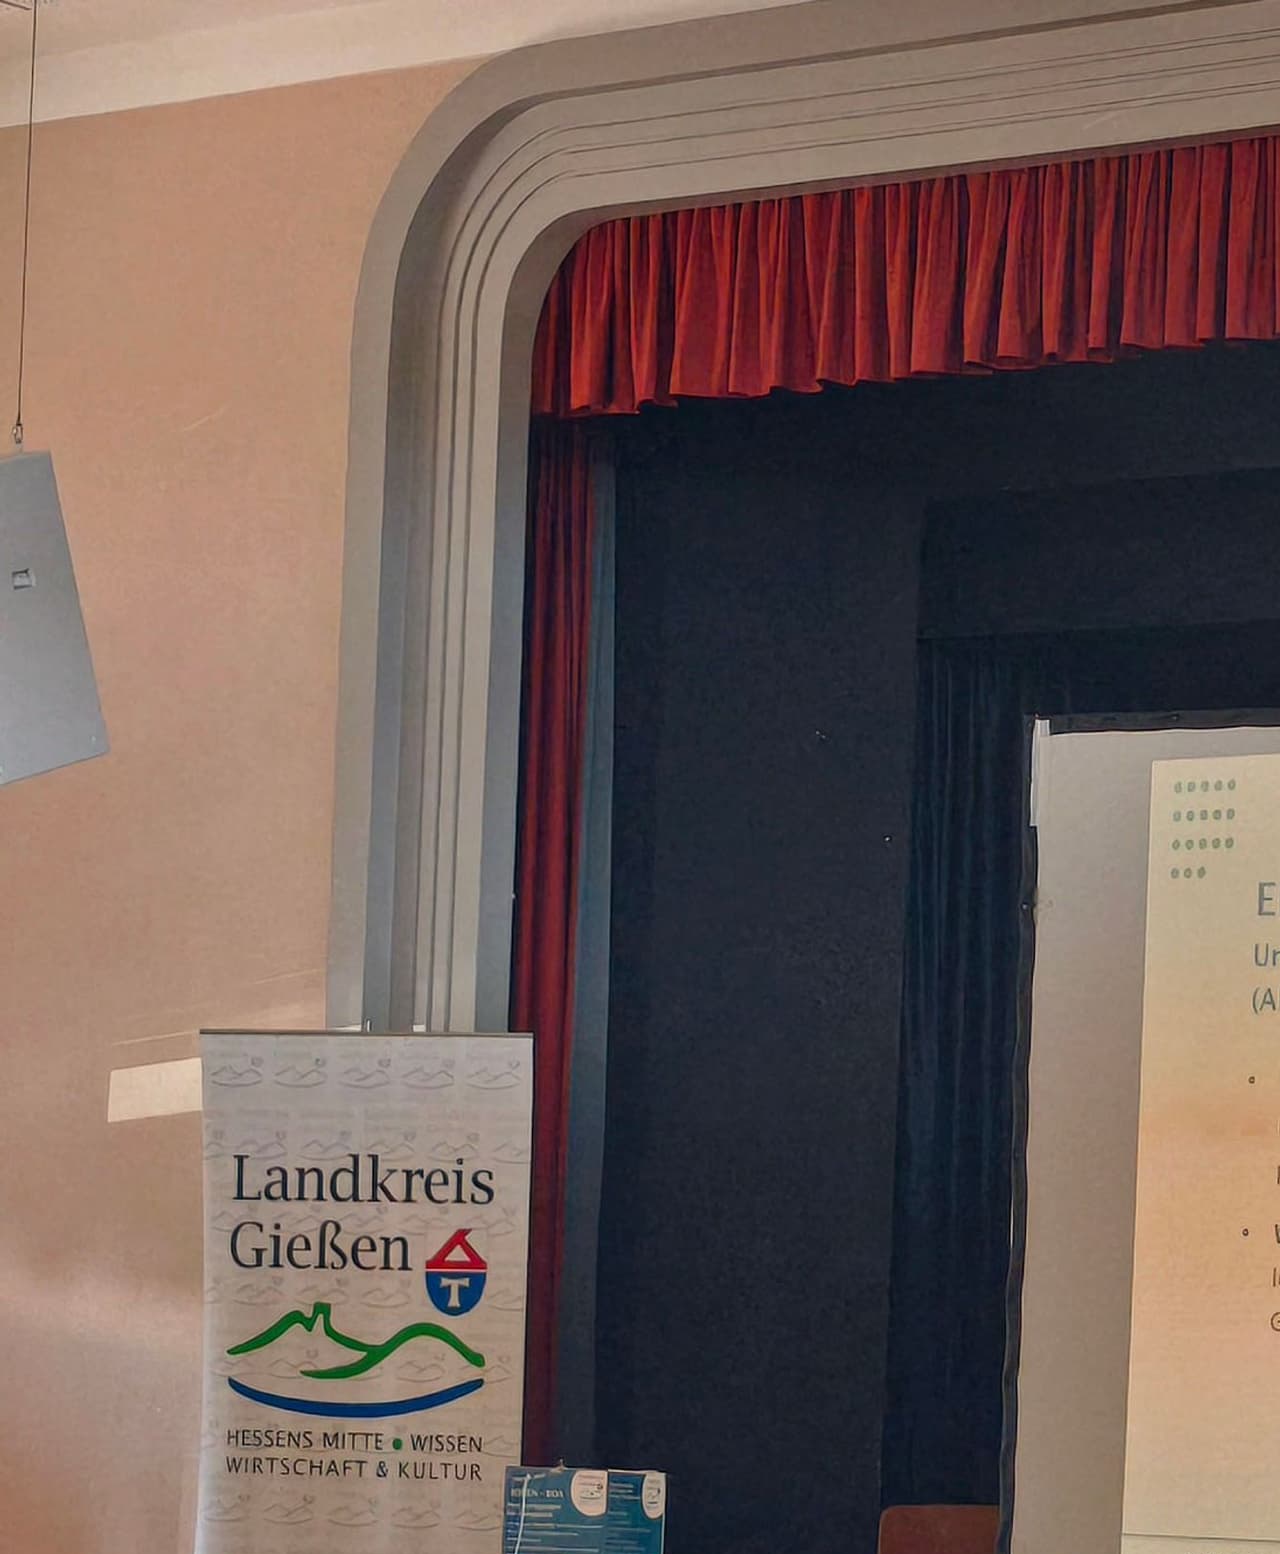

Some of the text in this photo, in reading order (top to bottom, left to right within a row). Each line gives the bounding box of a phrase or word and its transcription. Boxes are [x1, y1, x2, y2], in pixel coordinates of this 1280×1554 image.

[231, 1154, 495, 1206] Landkreis
[229, 1219, 413, 1272] Gießen
[227, 1429, 484, 1453] HESSENS MITTE WISSEN
[226, 1456, 483, 1481] WIRTSCHAFT & KULTUR
